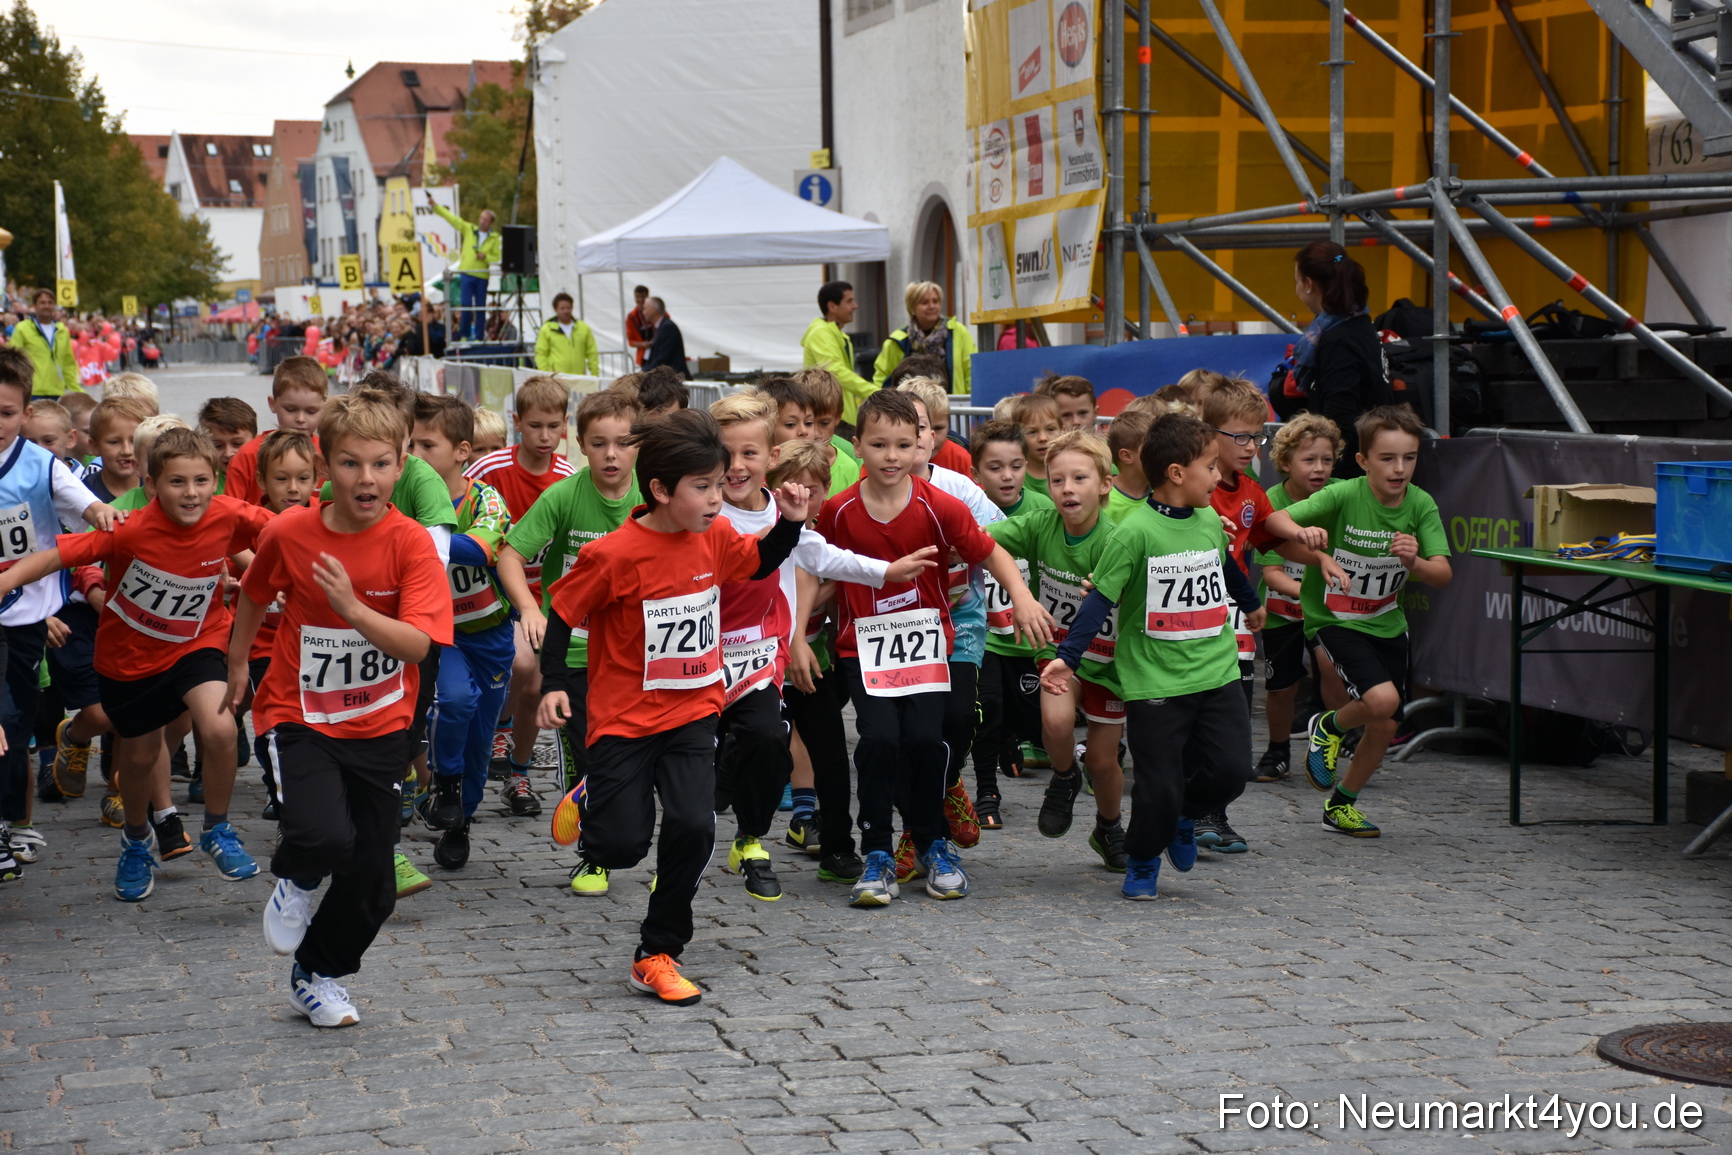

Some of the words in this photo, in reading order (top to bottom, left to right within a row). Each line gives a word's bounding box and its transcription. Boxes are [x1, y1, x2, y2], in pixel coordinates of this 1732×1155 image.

[397, 258, 415, 282] A
[1016, 250, 1039, 275] swn
[345, 266, 357, 283] B
[61, 286, 71, 300] C
[1345, 525, 1396, 539] Neumarkte
[1450, 516, 1521, 553] OFFICE
[1343, 534, 1388, 550] Stadtlauf
[1150, 566, 1182, 574] PARTL
[1184, 561, 1213, 573] Neumarkt
[1335, 555, 1363, 569] PARTL
[132, 564, 161, 584] PARTL
[164, 579, 205, 591] Neumarkt
[129, 577, 206, 618] 7112
[1041, 580, 1063, 597] PARTL
[1158, 572, 1221, 608] 7436
[647, 608, 681, 619] PARTL
[684, 599, 712, 614] Neumarkt
[138, 613, 169, 631] Leon
[858, 623, 889, 635] PARTL
[890, 616, 932, 630] Neumarkt
[657, 610, 713, 654] 7208
[303, 636, 339, 648] PARTL
[868, 629, 939, 667] 7427
[723, 648, 761, 658] eumarkt
[312, 650, 399, 687] 7188
[683, 661, 707, 676] Luis
[343, 691, 370, 707] Erik
[726, 679, 751, 702] imon
